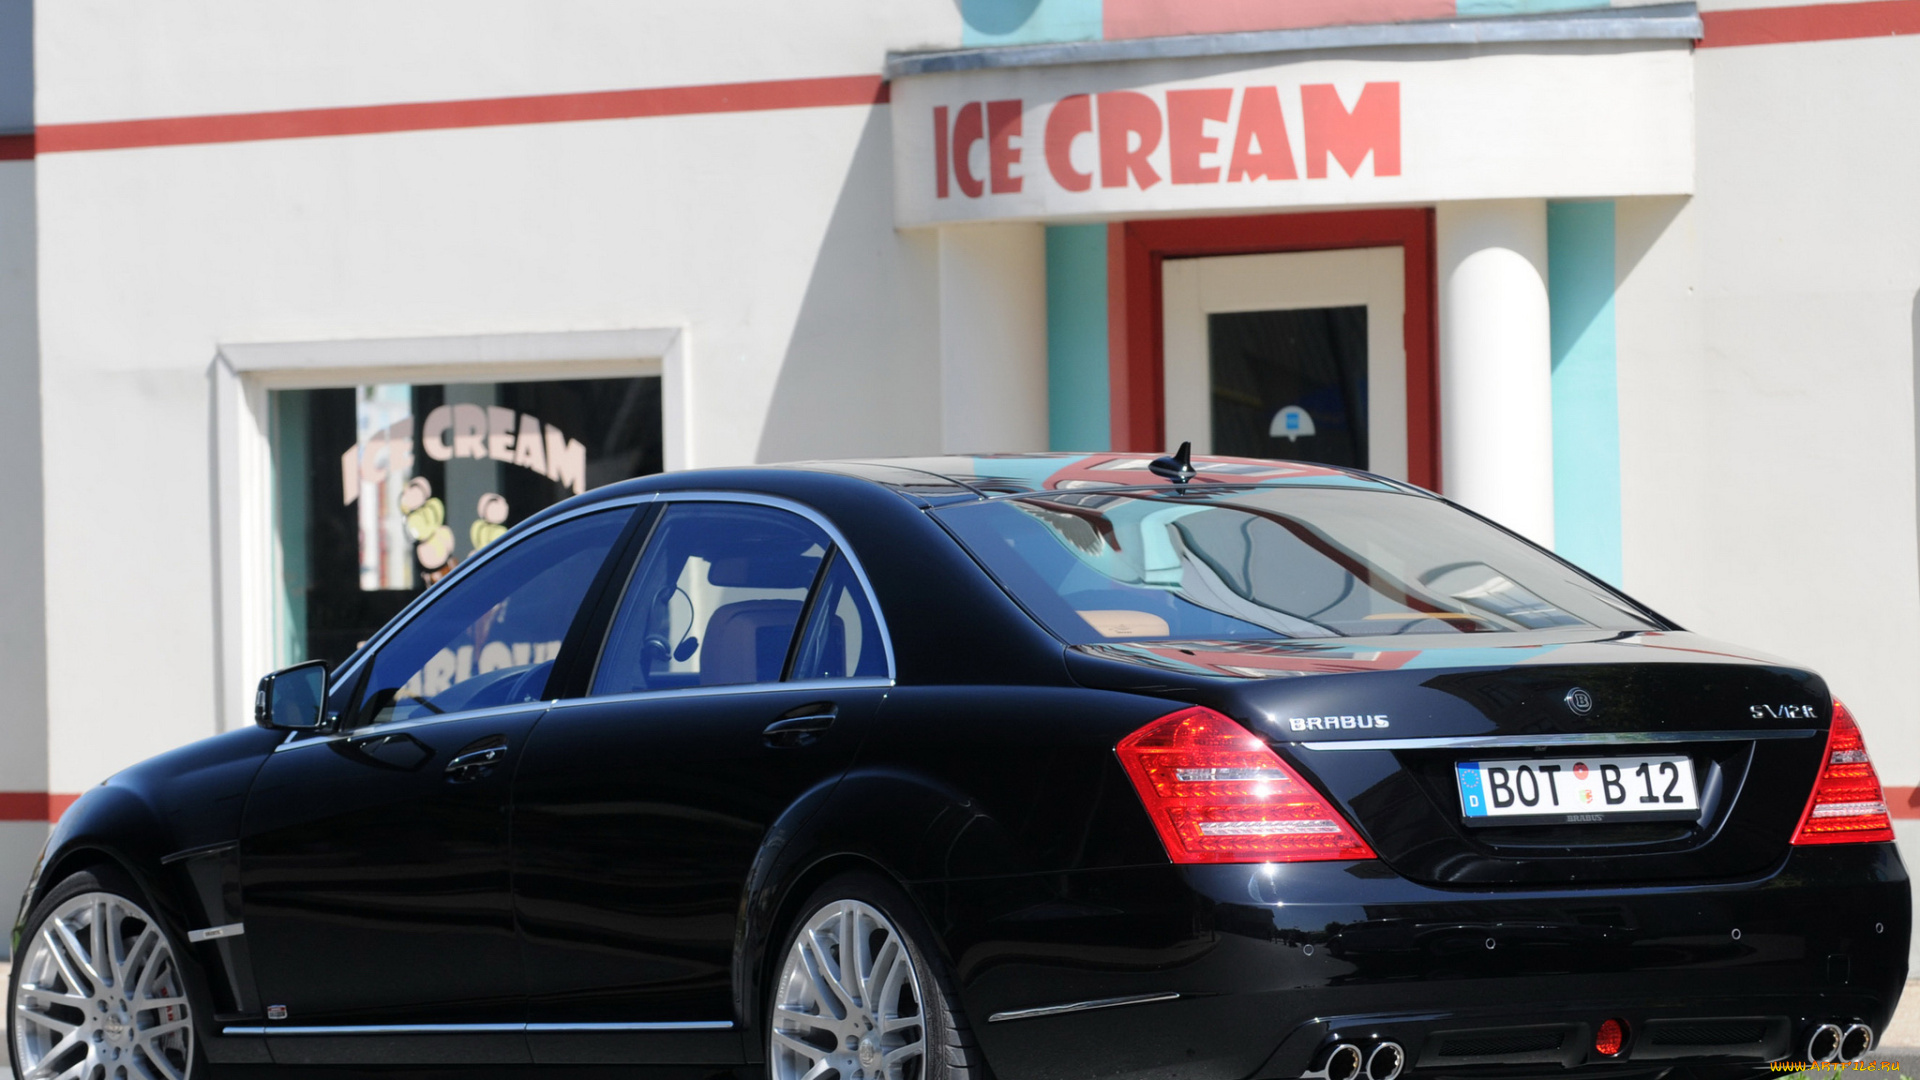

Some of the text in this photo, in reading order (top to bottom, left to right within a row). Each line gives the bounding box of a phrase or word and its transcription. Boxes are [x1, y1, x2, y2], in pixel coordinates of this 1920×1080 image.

[933, 81, 1401, 198] ICE CREAM
[341, 403, 587, 506] ICE CREAM
[1289, 715, 1390, 731] BRABUS
[1469, 795, 1480, 807] D
[1487, 765, 1561, 808] BOT
